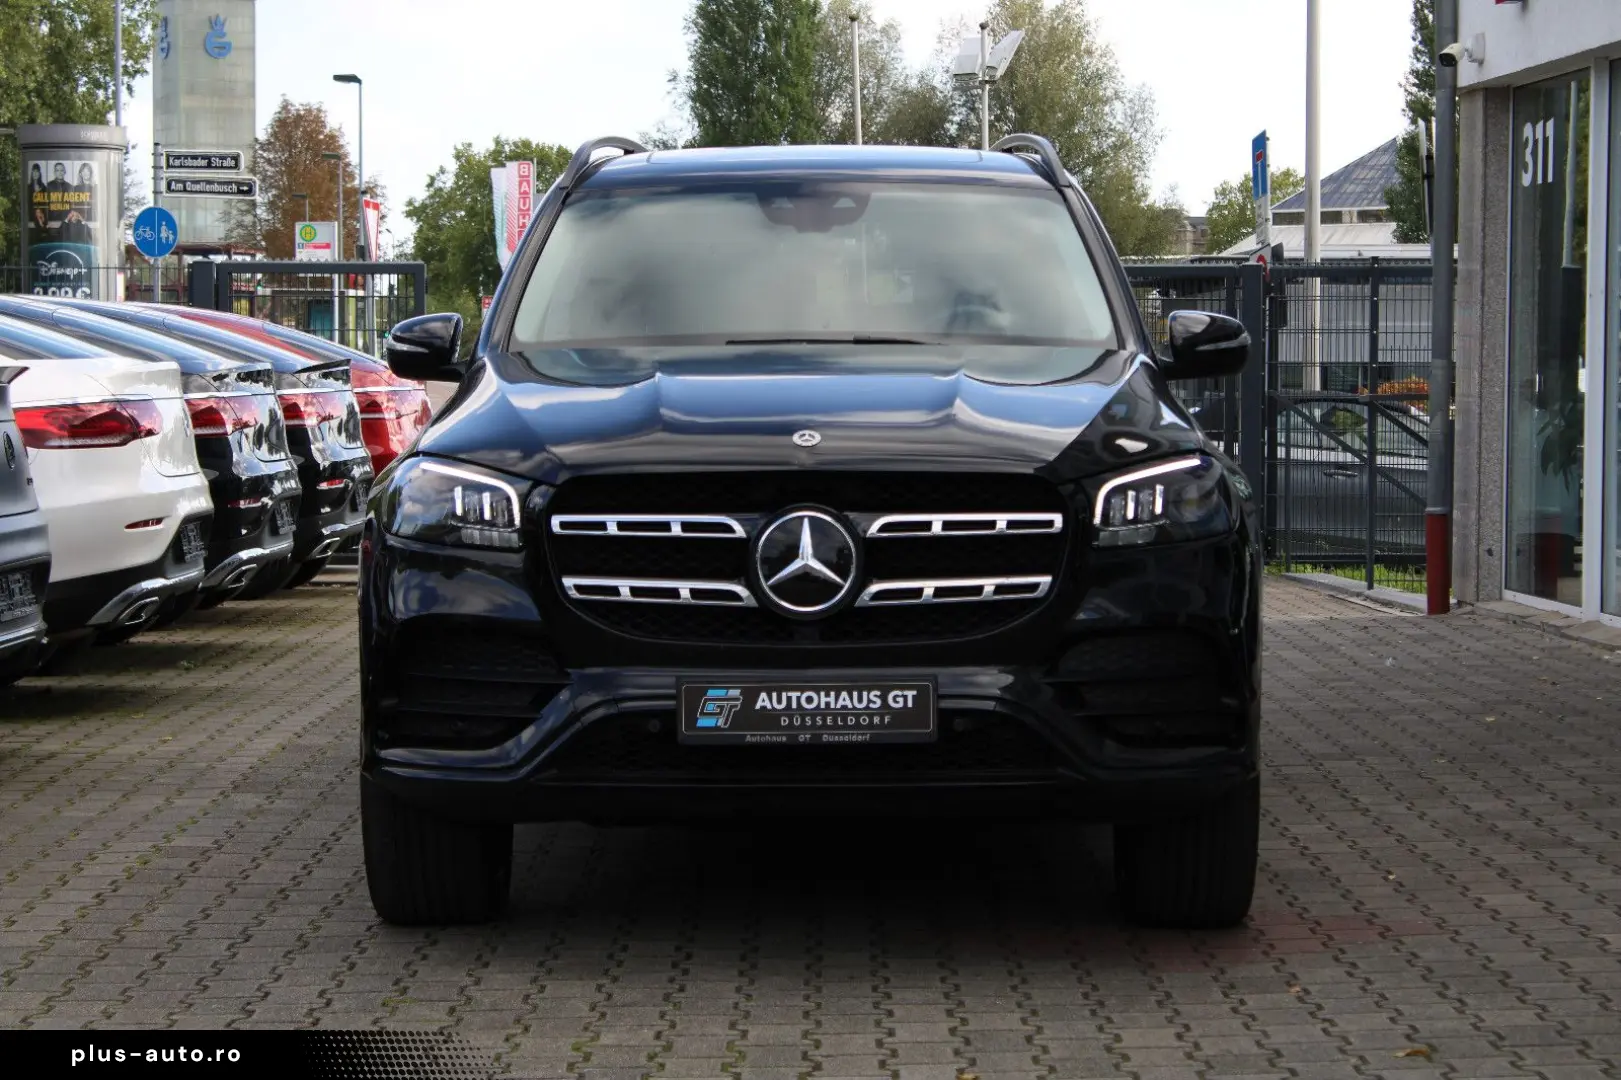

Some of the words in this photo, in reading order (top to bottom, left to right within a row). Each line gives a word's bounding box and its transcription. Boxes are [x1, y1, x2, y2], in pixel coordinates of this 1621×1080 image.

[1521, 118, 1554, 187] 311
[169, 156, 208, 168] Karlsbader
[211, 156, 236, 168] Straße
[170, 181, 184, 192] Am
[185, 181, 238, 193] Quellenbusch
[33, 192, 48, 203] CALL
[50, 192, 62, 202] MY
[63, 191, 90, 202] AGENT
[49, 202, 70, 211] BERLIN
[755, 690, 881, 710] AUTOHAUS
[887, 690, 917, 709] GT
[780, 712, 893, 726] DÜSSELDORF
[745, 734, 788, 742] Autohaus
[798, 734, 811, 742] GT
